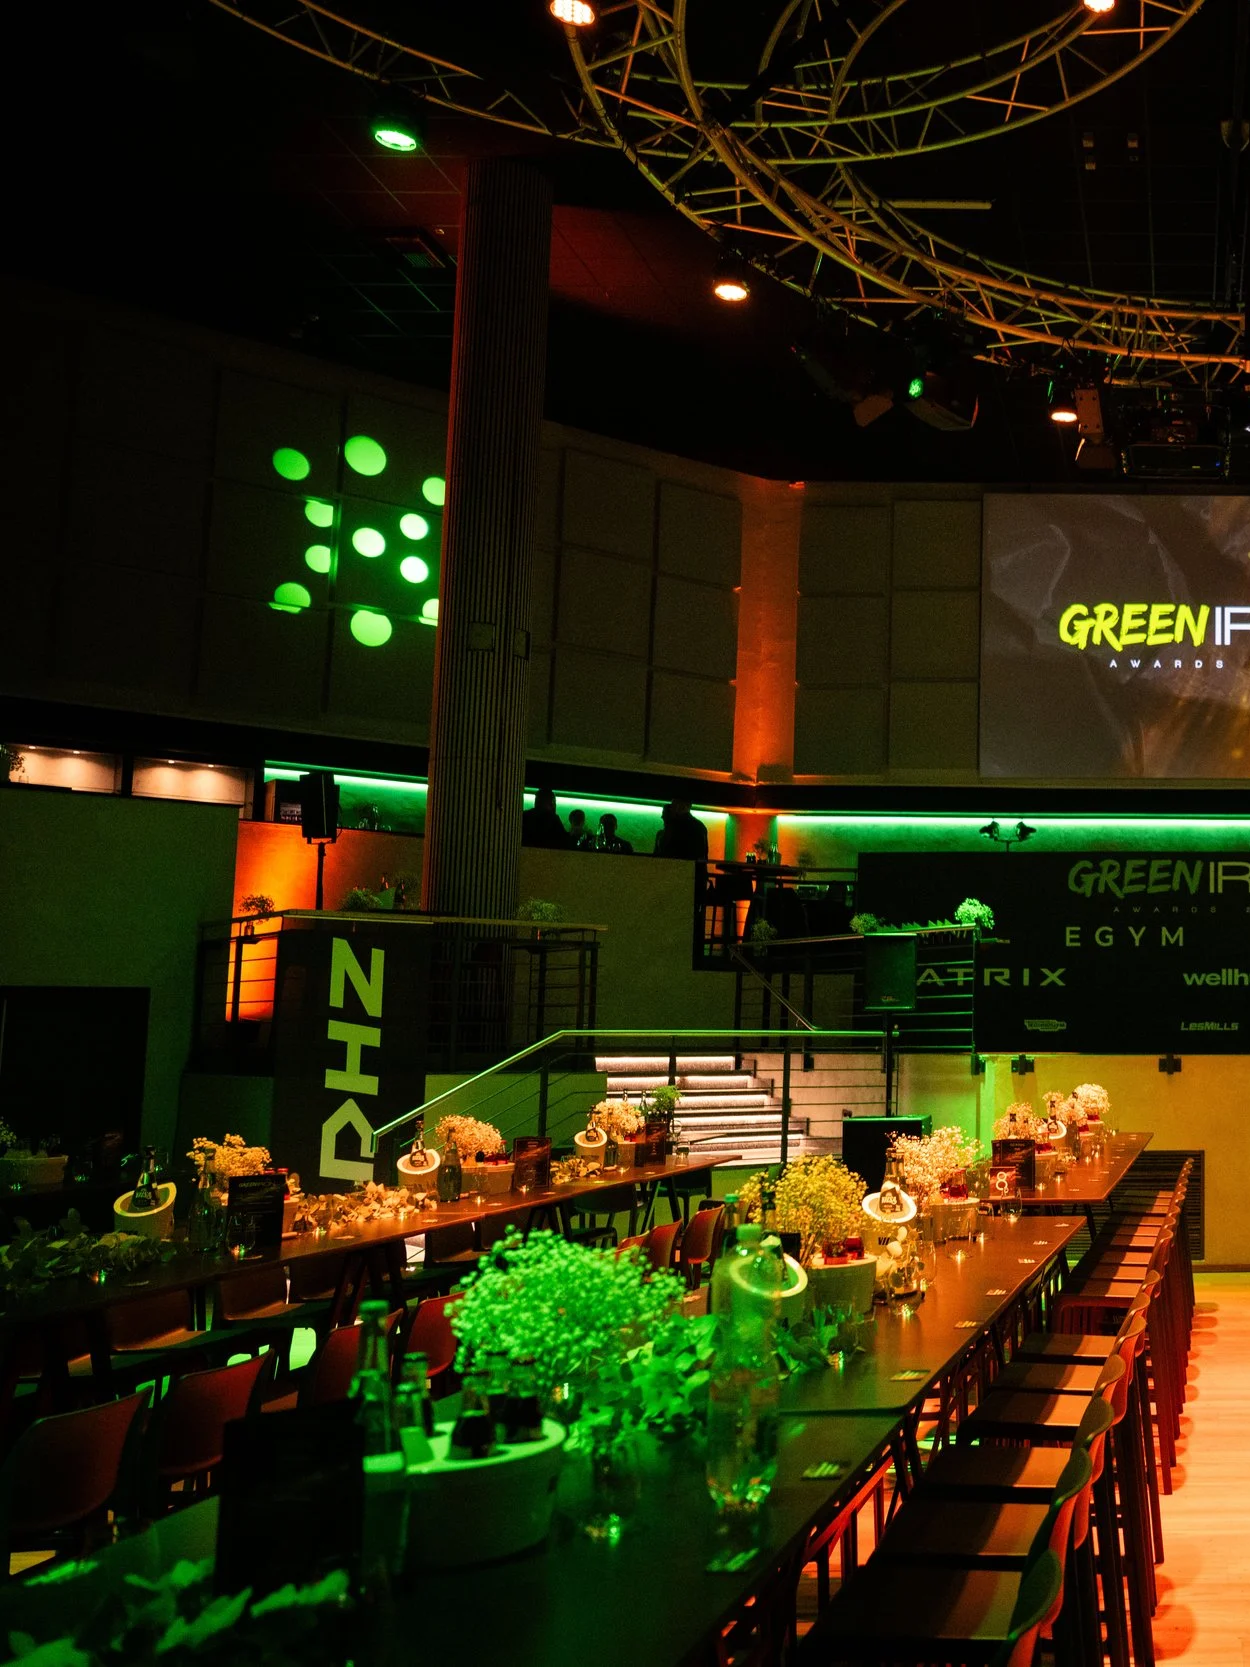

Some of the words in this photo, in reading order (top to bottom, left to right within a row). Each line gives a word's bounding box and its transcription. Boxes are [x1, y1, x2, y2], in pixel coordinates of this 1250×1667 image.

[1109, 659, 1224, 669] AWARDS
[1113, 906, 1217, 914] AWARDS
[1065, 926, 1184, 947] EGYM
[916, 967, 1067, 987] ATRIX
[319, 937, 385, 1182] DHZ
[996, 1171, 1008, 1191] 8
